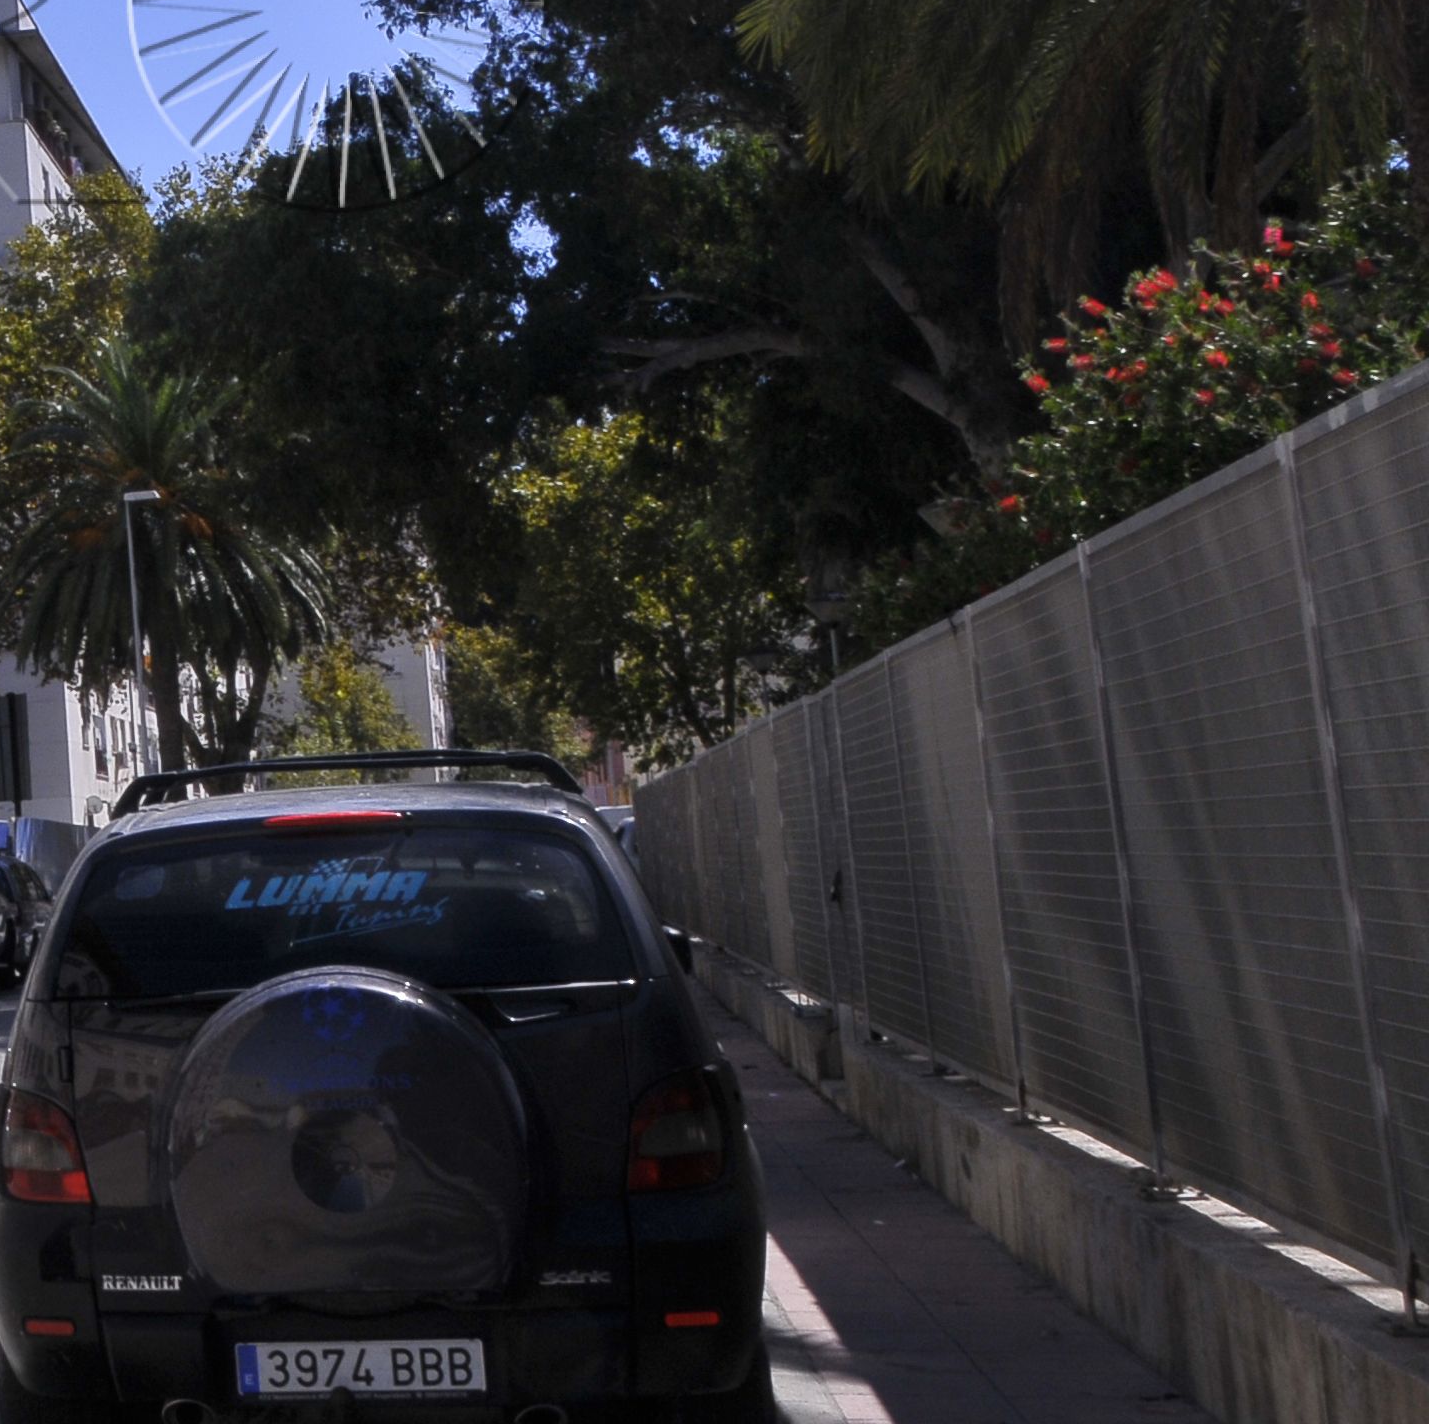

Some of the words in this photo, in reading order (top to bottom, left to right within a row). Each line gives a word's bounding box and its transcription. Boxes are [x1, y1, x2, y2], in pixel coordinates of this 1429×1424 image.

[225, 870, 428, 910] LUMMA
[335, 896, 450, 930] Tuning
[101, 1274, 183, 1291] RENAULT
[267, 1348, 375, 1388] 3974
[390, 1347, 473, 1387] BBB
